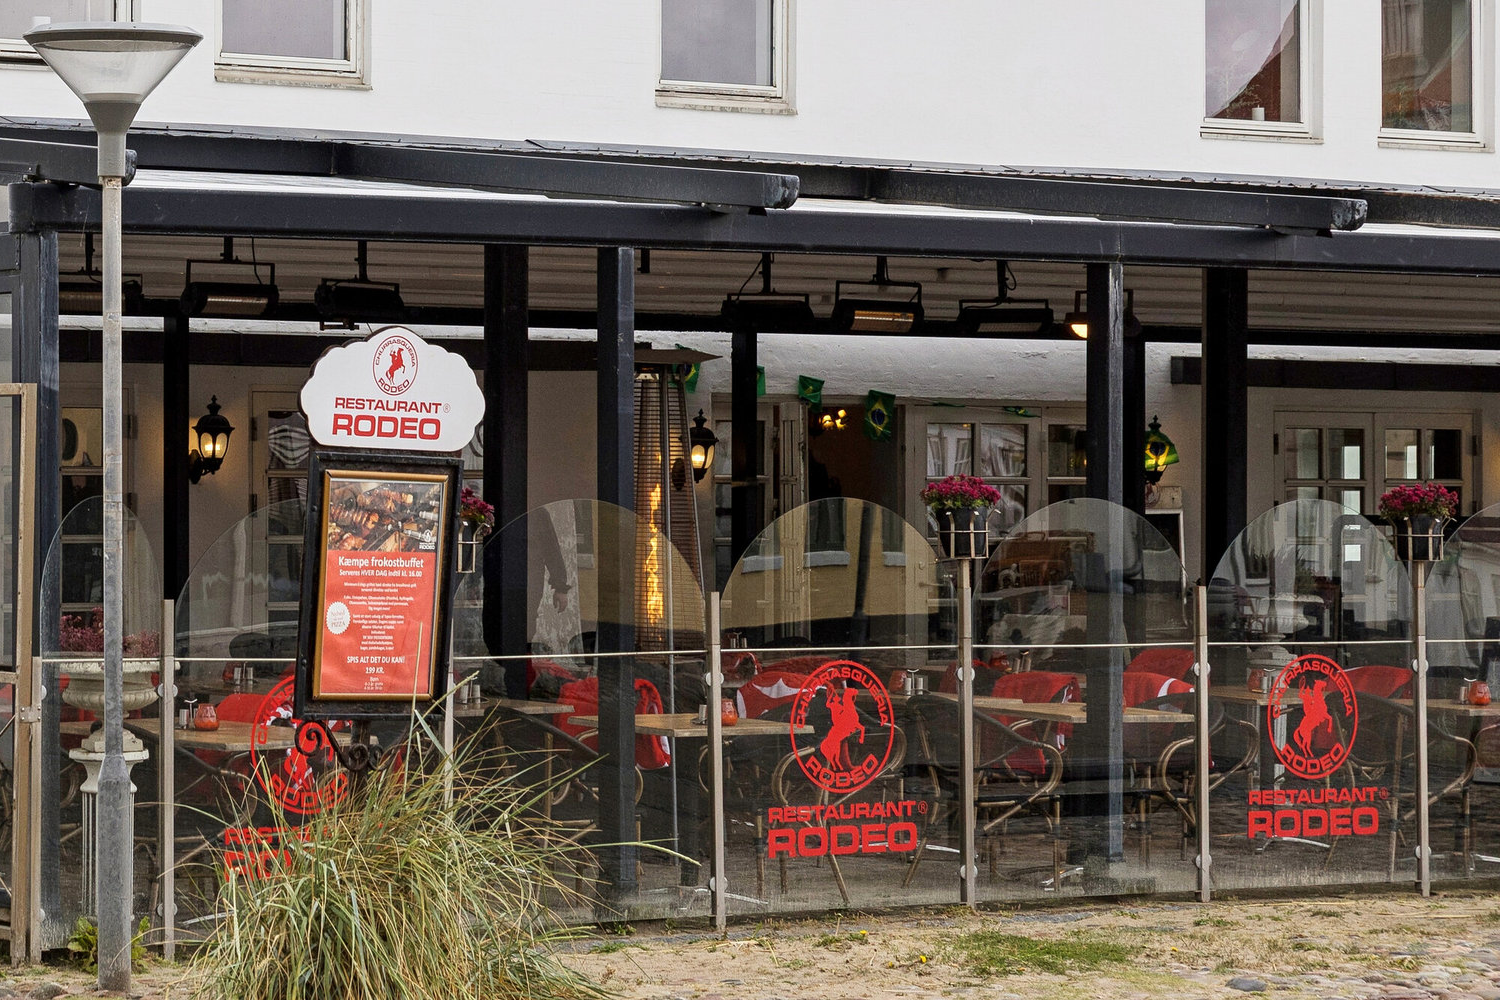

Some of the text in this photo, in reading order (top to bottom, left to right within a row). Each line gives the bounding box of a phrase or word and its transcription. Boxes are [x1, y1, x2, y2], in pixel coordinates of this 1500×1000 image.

[375, 338, 415, 367] CHURRASQUERIA
[378, 377, 410, 393] RODEO
[334, 397, 442, 414] RESTAURANT
[332, 413, 441, 441] RODEO
[338, 556, 424, 568] Kæmpe frokostbuffet
[361, 569, 375, 577] HVER
[376, 569, 387, 577] DAG
[347, 656, 359, 664] SPIS
[360, 656, 369, 664] ALT
[370, 656, 381, 664] DET
[382, 656, 390, 664] DU
[796, 667, 889, 728] CHURRASQUERIA
[1272, 661, 1353, 718] CHURRASQUERIA
[805, 753, 878, 787] RODEO
[1281, 743, 1344, 774] RODEO
[1248, 787, 1378, 805] RESTAURANT
[768, 801, 916, 824] RESTAURANT
[1248, 807, 1379, 839] RODEO
[768, 822, 918, 859] RODEO
